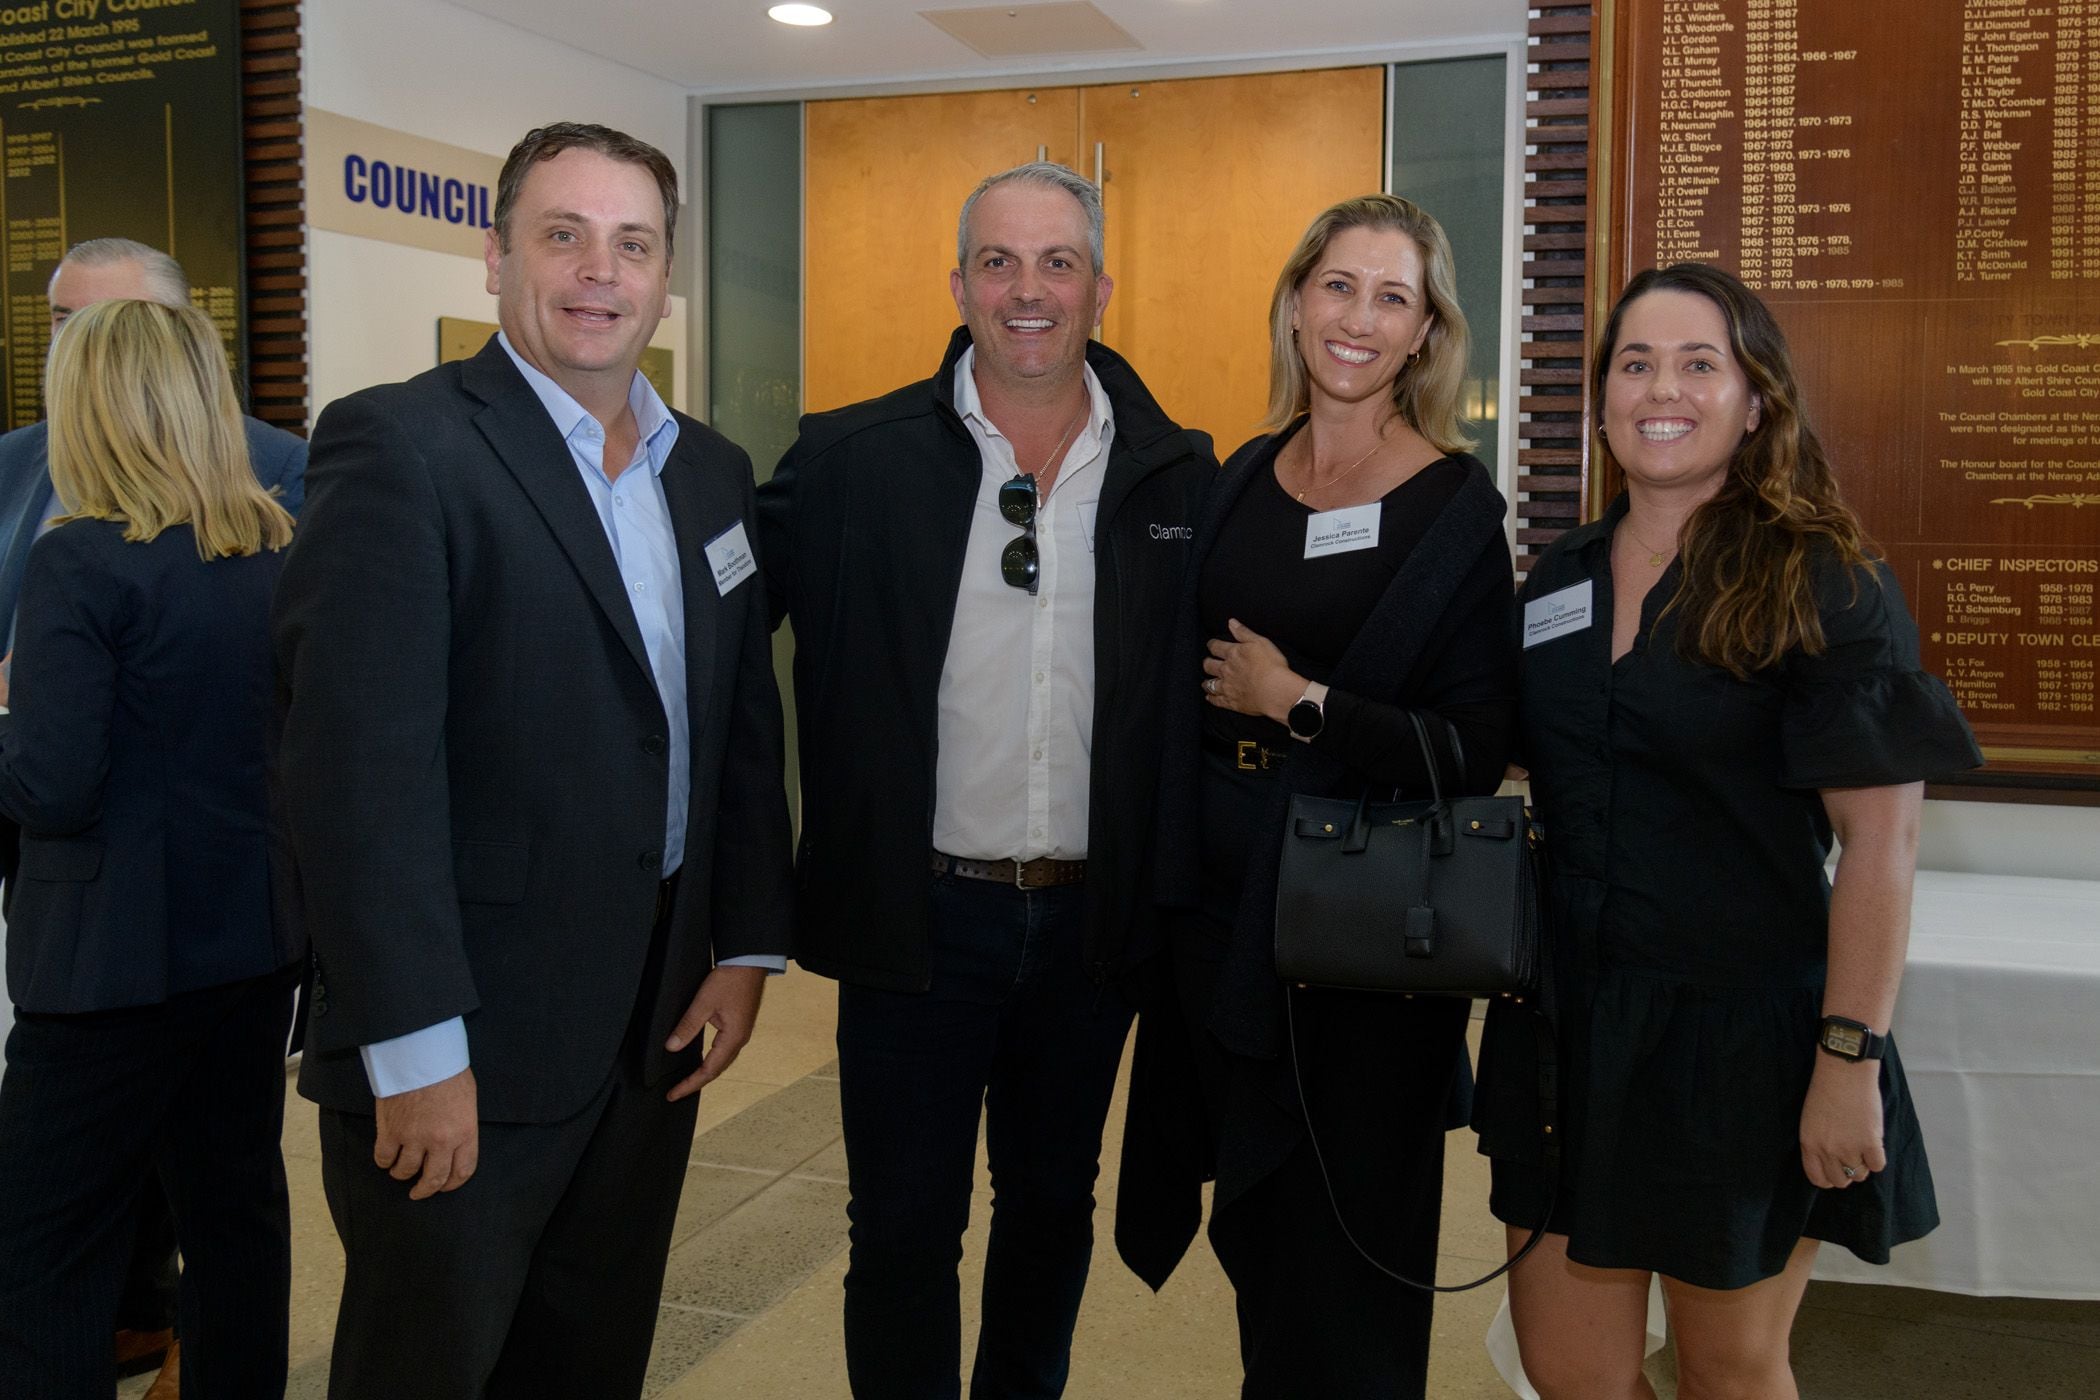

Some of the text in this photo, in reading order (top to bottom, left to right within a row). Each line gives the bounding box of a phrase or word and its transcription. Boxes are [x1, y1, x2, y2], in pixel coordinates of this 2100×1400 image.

[1693, 3, 1719, 11] Ulrick
[0, 0, 100, 25] oast City
[1688, 13, 1726, 23] Winders
[49, 18, 140, 41] 22 March 1995
[1686, 23, 1734, 33] Woodroffe
[1681, 35, 1717, 44] Gordon
[1964, 31, 2049, 42] Sir John Egerton
[5, 30, 208, 63] Coast City Council was formed
[1682, 45, 1720, 54] Graham
[1986, 40, 2080, 53] Thompson 1979
[67, 60, 88, 71] the
[137, 50, 172, 63] Gold
[175, 45, 216, 60] Coast
[1684, 56, 1717, 67] Murray
[1988, 54, 2019, 63] Peters
[1685, 67, 1720, 77] Samuel
[1987, 64, 2012, 74] Field
[62, 75, 93, 87] Shire
[1680, 78, 1722, 87] Thurecht
[1984, 74, 2079, 87] Hughes 1982
[1681, 88, 1731, 98] Godlonton
[1986, 88, 2015, 98] Taylor
[1693, 100, 1727, 110] Pepper
[2000, 98, 2047, 108] Coomber
[1984, 109, 2031, 118] Workman
[1671, 121, 1716, 131] Neumann
[1985, 118, 2078, 129] Pie 1985
[1685, 132, 1712, 142] Short
[1983, 130, 2002, 139] Bell
[1690, 143, 1722, 153] Bloyce
[1983, 141, 2021, 150] Webber
[1675, 154, 1703, 163] Gibbs
[1983, 152, 2012, 161] Gibbs
[1681, 165, 1720, 175] Kearney
[1981, 173, 2012, 184] Bergin
[1677, 187, 1708, 196] Overell
[1678, 197, 1703, 207] Laws
[1677, 208, 1704, 217] Thorn
[1980, 206, 2017, 215] Rickard
[1677, 219, 1694, 228] Cox
[1673, 229, 1700, 238] Evans
[2051, 225, 2074, 235] 1991
[1677, 240, 1699, 248] Hunt
[1983, 238, 2028, 248] Crichlow
[1676, 249, 1719, 259] O'Connell
[1981, 248, 2074, 259] Smith 1991
[1740, 258, 1793, 268] 1970 1973
[1977, 261, 2028, 270] McDonald
[1980, 271, 2012, 280] Turner
[1947, 364, 2090, 374] In March 1995 the Gold Coast
[1972, 377, 1992, 386] with
[1996, 377, 2011, 385] the
[2014, 376, 2043, 385] Albert
[2046, 376, 2071, 385] Shire
[2022, 388, 2100, 398] Gold Coast City
[1939, 412, 1957, 421] The
[1959, 412, 1996, 421] Council
[1998, 412, 2047, 421] Chambers
[2050, 412, 2059, 421] at
[2063, 412, 2079, 421] the
[1950, 424, 2086, 434] were then designated as the
[2013, 436, 2088, 447] for meetings of
[1940, 459, 1958, 468] The
[1961, 459, 1996, 468] Honour
[1999, 459, 2027, 468] board
[2030, 459, 2044, 468] for
[2048, 460, 2063, 468] the
[1965, 471, 2083, 482] Chambers at the Nerang
[1313, 528, 1369, 543] Jessica Parente
[1947, 558, 2099, 573] CHIEF INSPECTORS
[1969, 583, 1995, 593] Perry
[1969, 594, 2012, 603] Chesters
[1965, 605, 2021, 616] Schamburg
[1528, 618, 1552, 630] Phoebe
[1553, 606, 1586, 621] Cumming
[1960, 615, 1990, 625] Briggs
[1946, 632, 2009, 645] DEPUTY
[2017, 633, 2064, 646] TOWN
[1969, 658, 1985, 667] Fox
[2036, 659, 2061, 668] 1958
[1970, 669, 2004, 679] Angove
[1955, 680, 1996, 689] Hamilton
[1968, 691, 1998, 700] Brown
[1981, 700, 2015, 710] Towson
